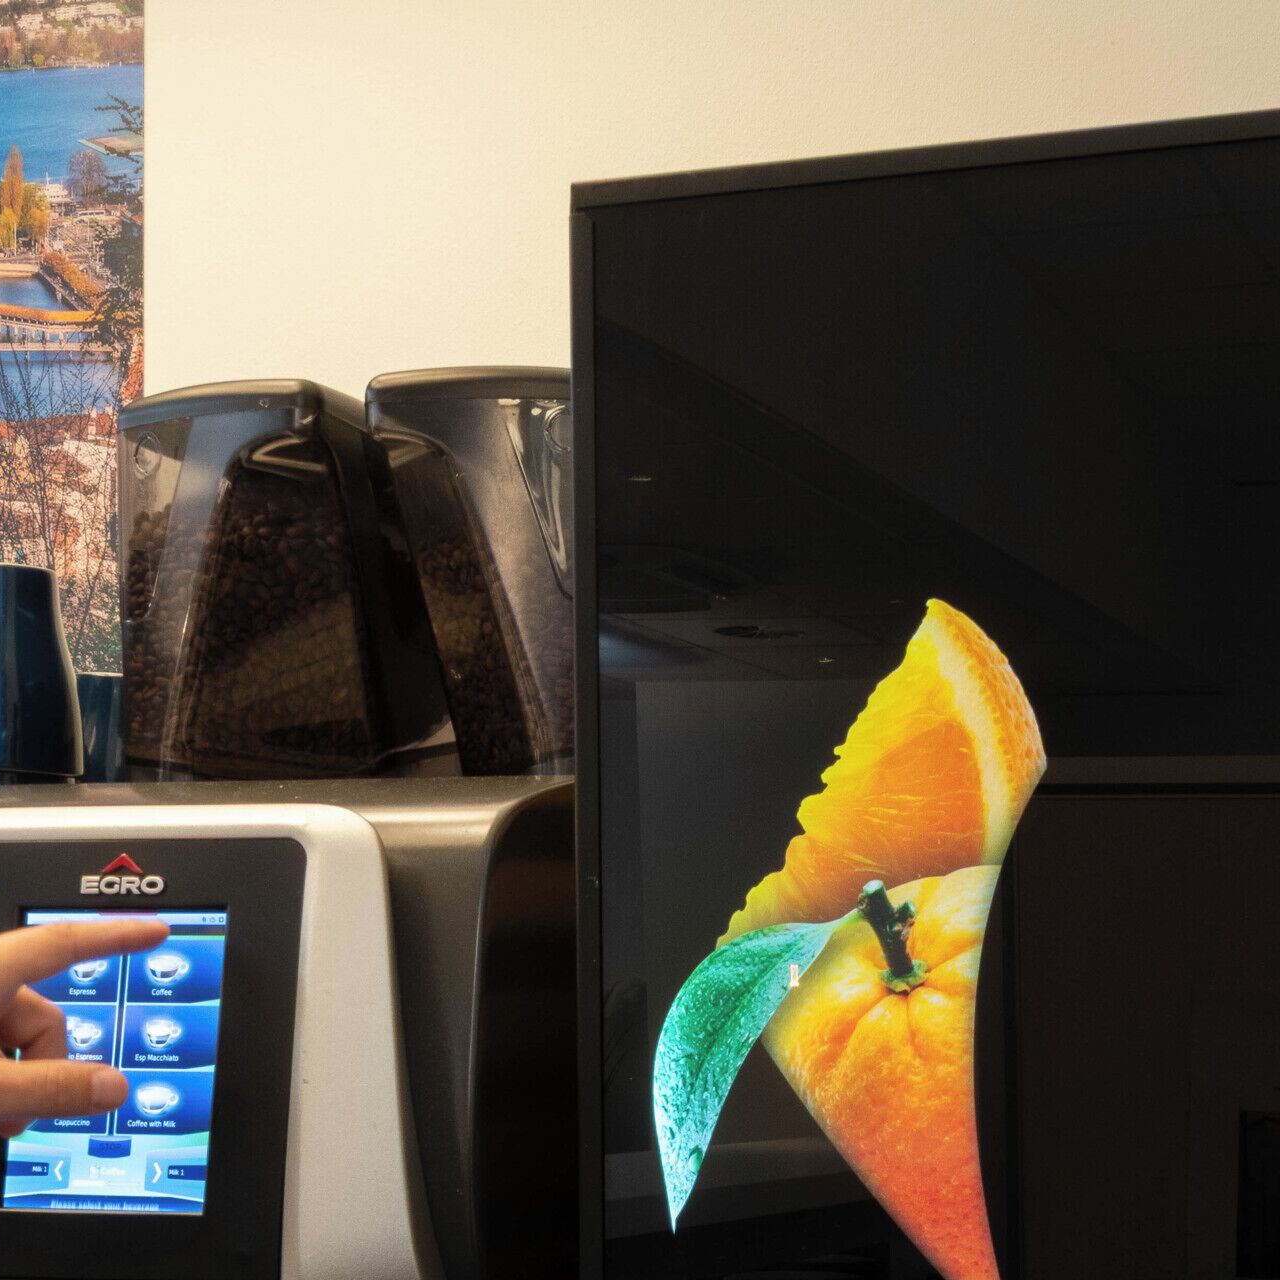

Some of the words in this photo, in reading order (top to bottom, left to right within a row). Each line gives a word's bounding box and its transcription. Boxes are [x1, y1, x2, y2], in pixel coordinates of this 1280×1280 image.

[81, 875, 165, 895] EGRO
[69, 987, 97, 996] Espresso
[151, 988, 173, 996] Coffee
[76, 1052, 103, 1061] Espresso
[135, 1053, 147, 1062] Esp
[54, 1118, 90, 1127] Cappuccino
[127, 1119, 148, 1127] Coffee
[149, 1119, 162, 1127] with
[163, 1120, 176, 1128] Milk
